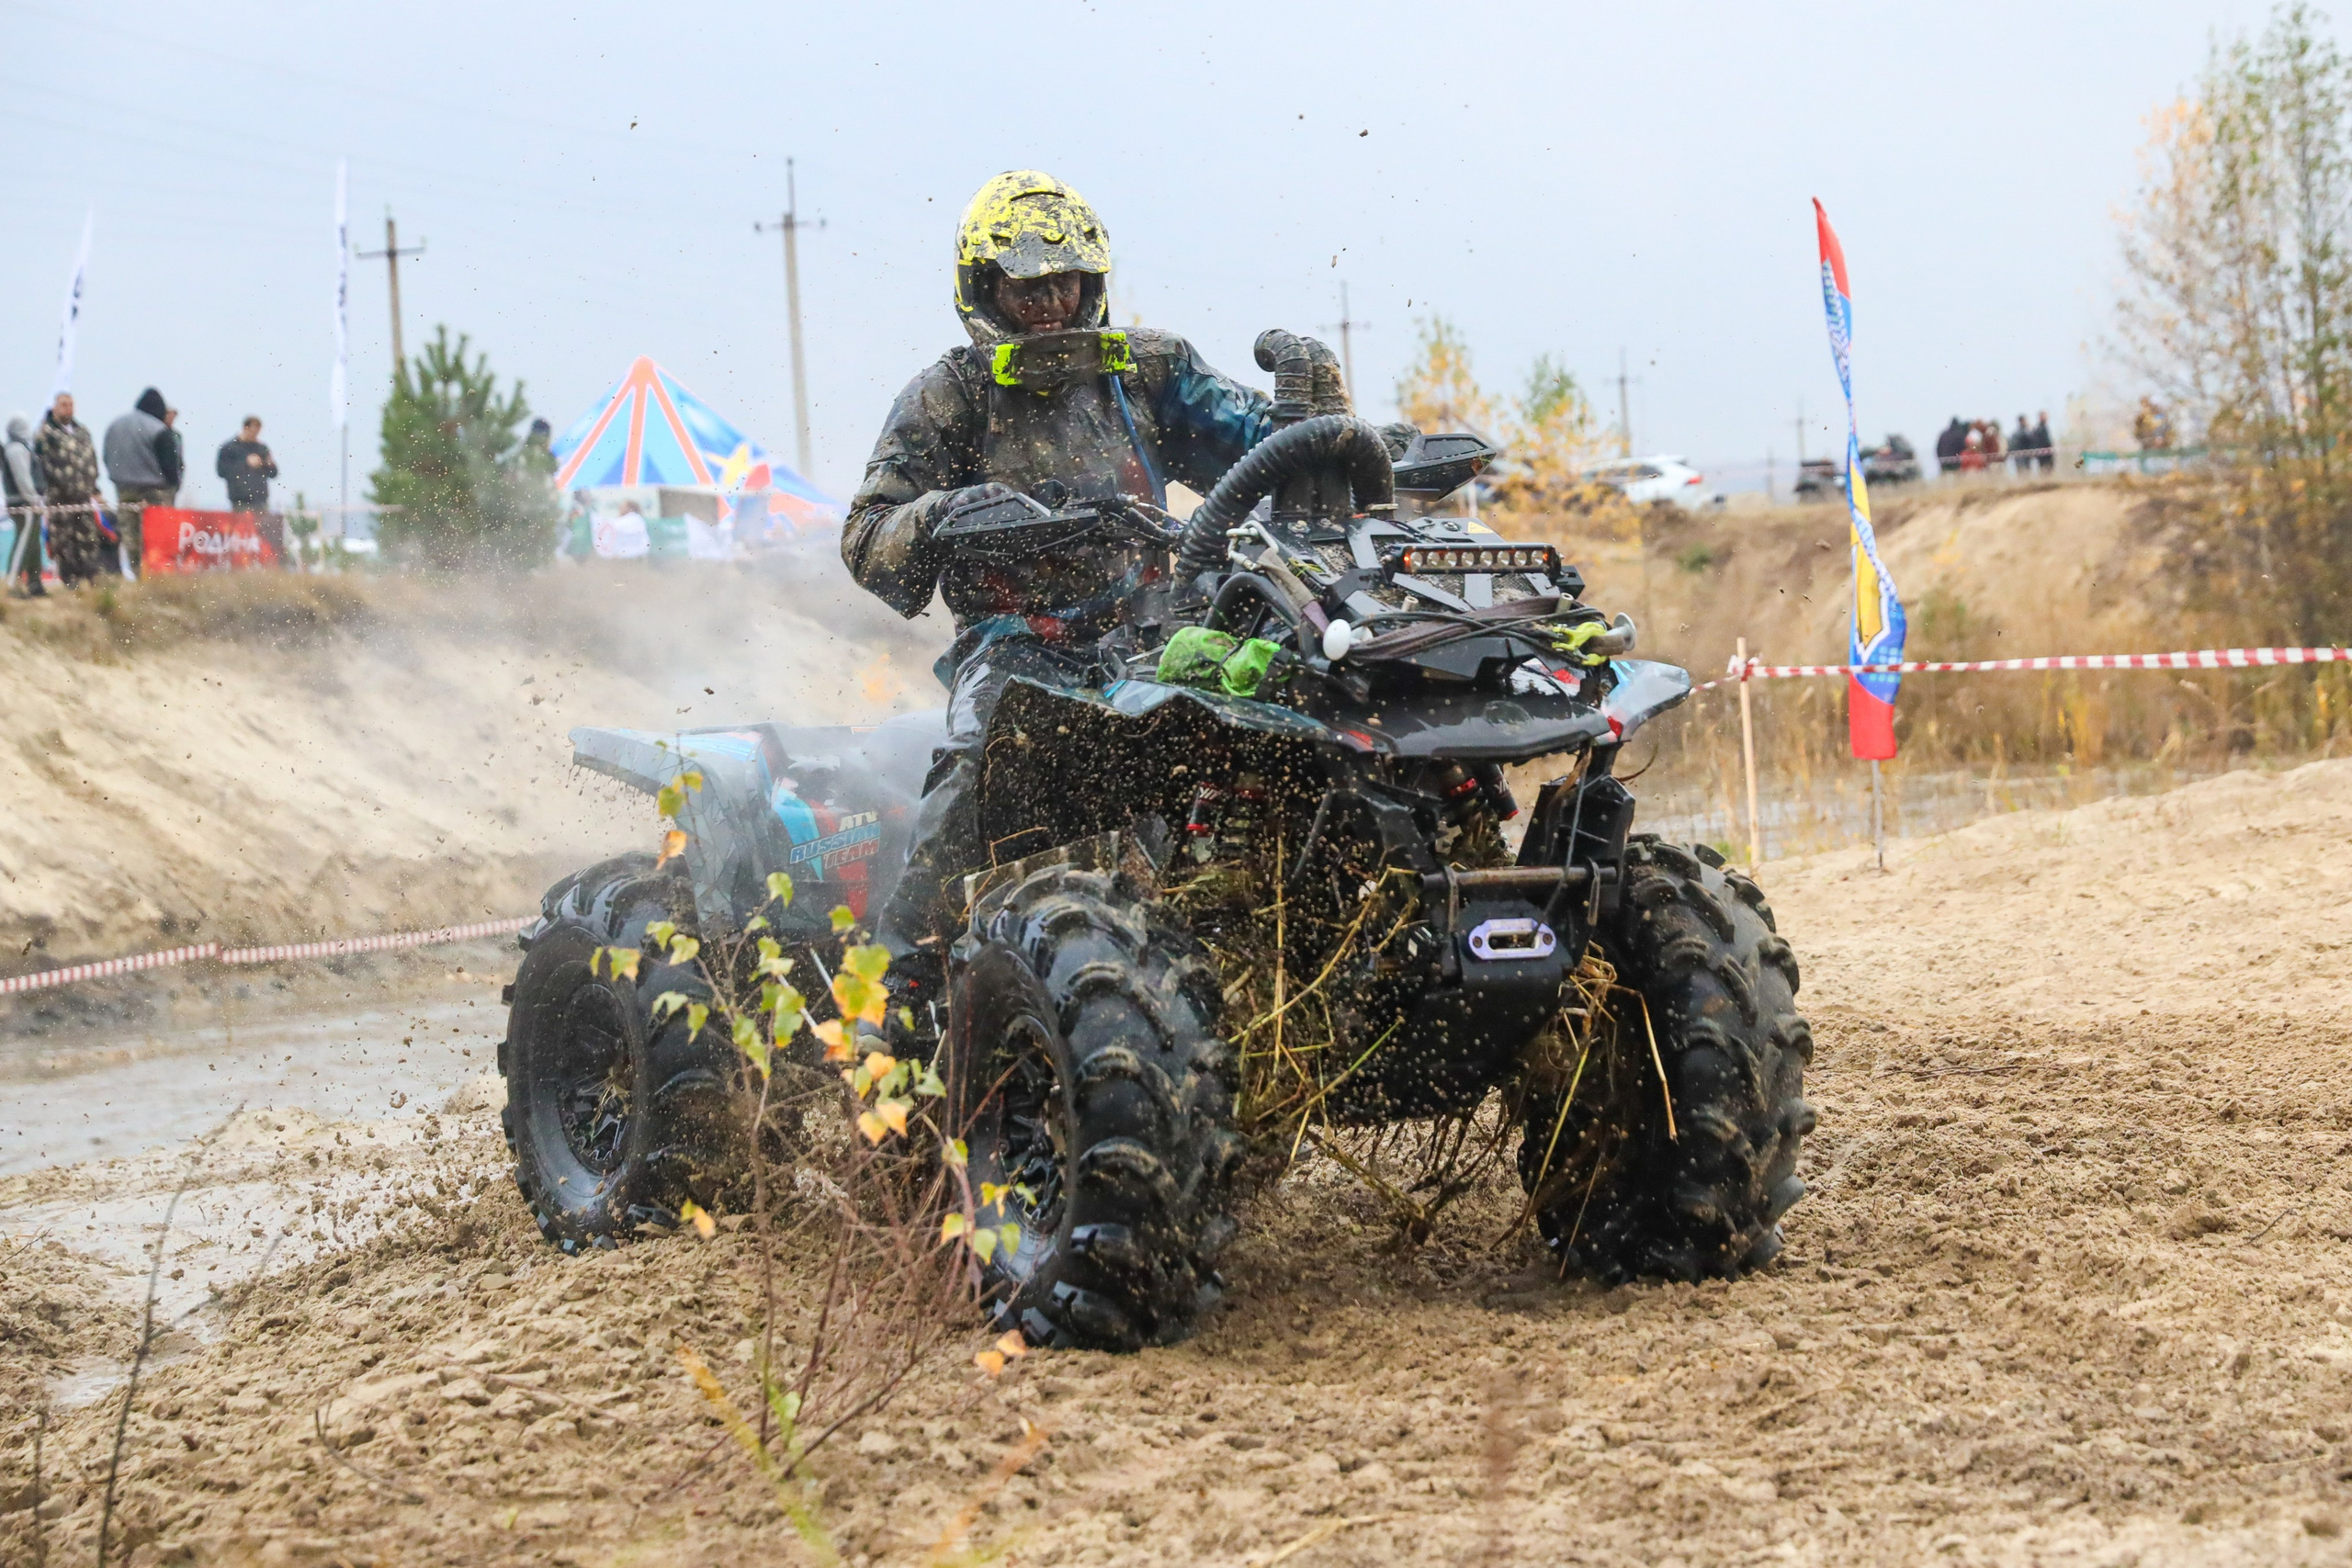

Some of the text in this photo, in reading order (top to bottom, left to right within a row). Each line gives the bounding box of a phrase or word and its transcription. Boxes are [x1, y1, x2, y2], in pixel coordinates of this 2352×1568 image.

[839, 810, 878, 831] ATV
[790, 821, 881, 863] RUSSIAN
[823, 838, 880, 869] TEAM
